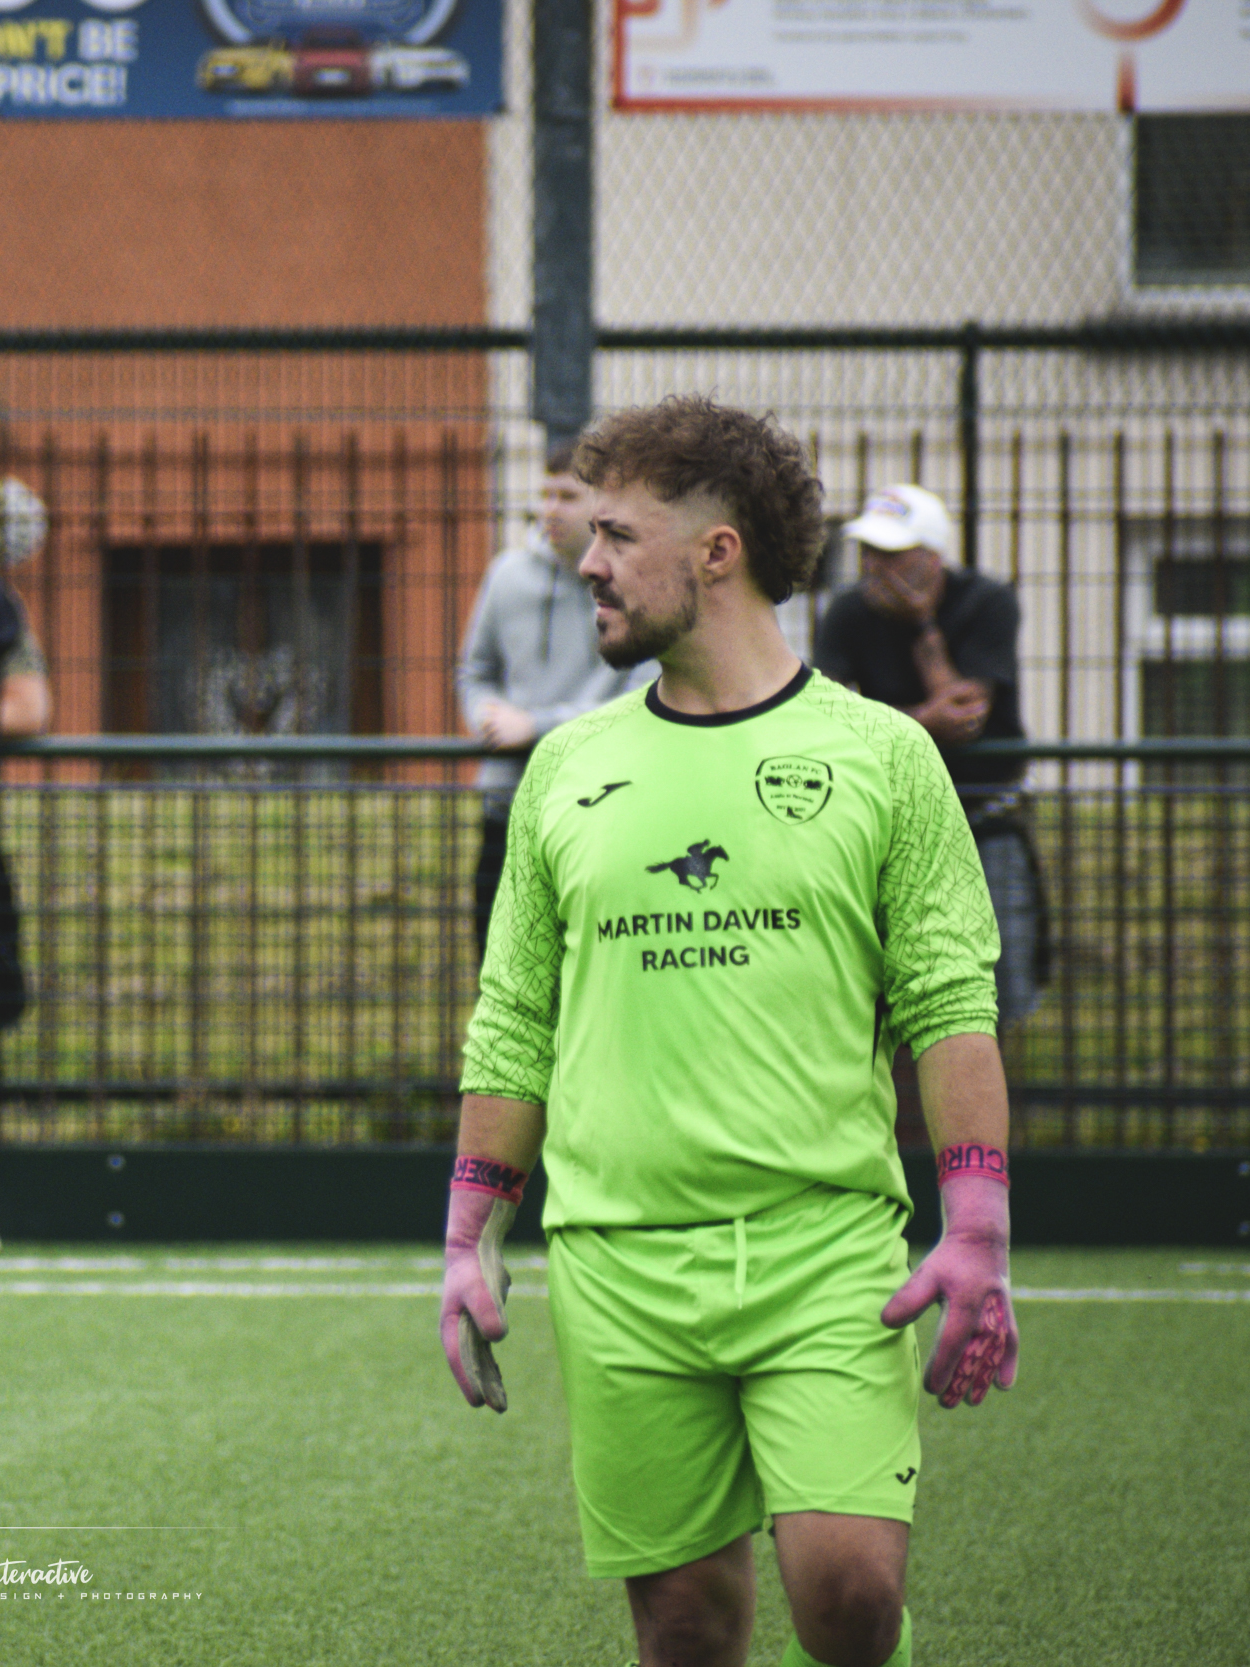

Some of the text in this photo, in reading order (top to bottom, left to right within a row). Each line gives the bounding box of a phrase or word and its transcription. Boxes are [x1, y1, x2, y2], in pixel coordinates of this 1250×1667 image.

[78, 20, 139, 60] BE
[598, 908, 801, 943] MARTIN DAVIES
[642, 945, 750, 972] RACING
